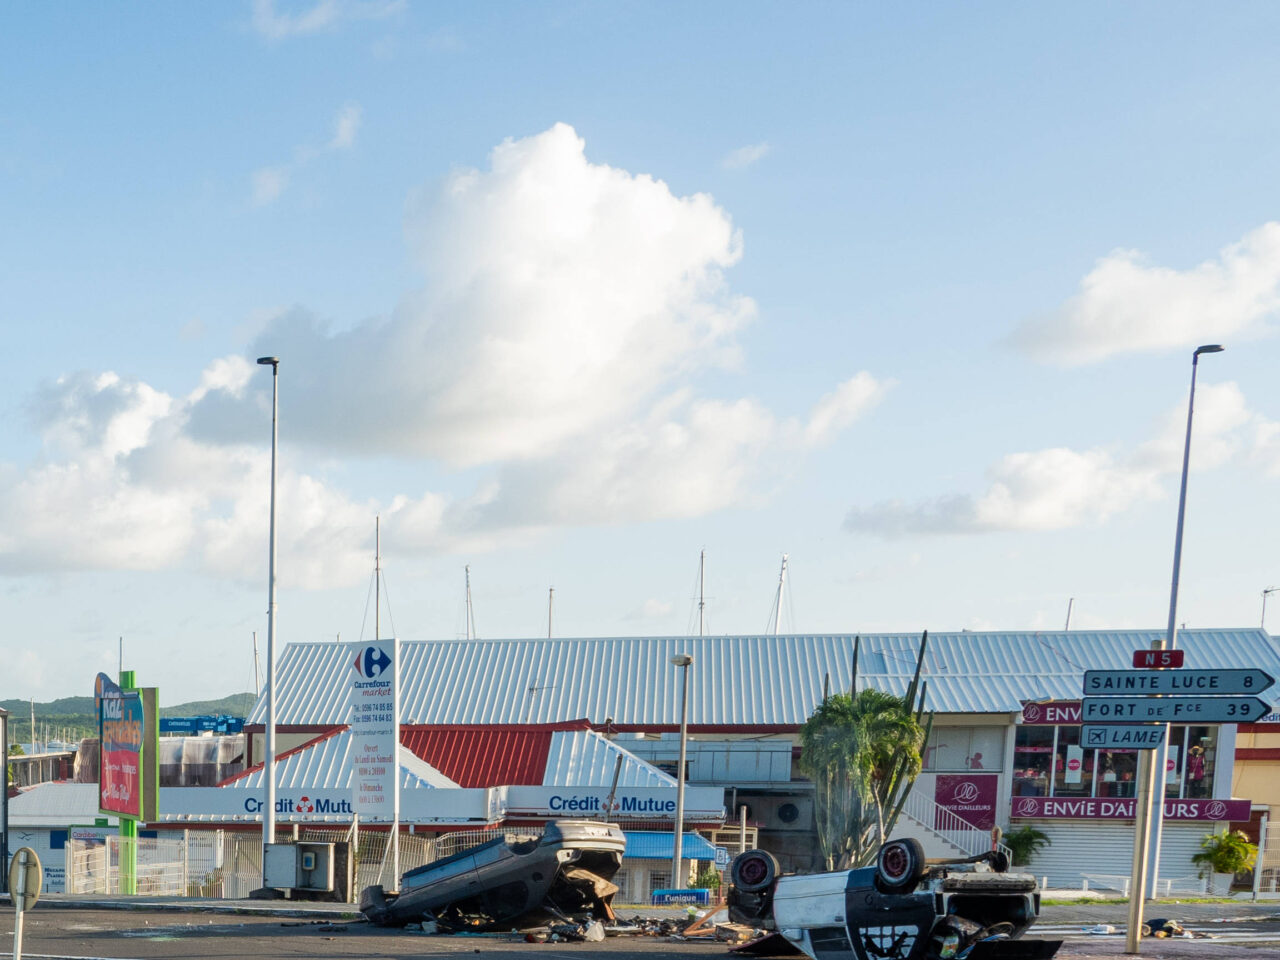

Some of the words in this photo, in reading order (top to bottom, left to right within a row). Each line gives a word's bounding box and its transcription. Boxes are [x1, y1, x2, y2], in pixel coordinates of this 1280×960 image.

[1145, 653, 1155, 665] N
[1161, 653, 1170, 665] 5
[354, 680, 391, 688] Carrefour
[1091, 676, 1160, 689] SAINTE
[1172, 676, 1219, 688] LUCE
[1243, 676, 1253, 688] 8
[362, 687, 392, 696] market
[1046, 707, 1081, 721] ENV
[1088, 703, 1136, 716] FORT
[1147, 707, 1163, 716] DE
[1227, 703, 1250, 716] 39
[1112, 731, 1165, 743] LAME
[244, 796, 294, 813] Crdit
[315, 798, 353, 813] Mutu
[549, 795, 599, 811] Crédit
[622, 796, 676, 812] Mutue
